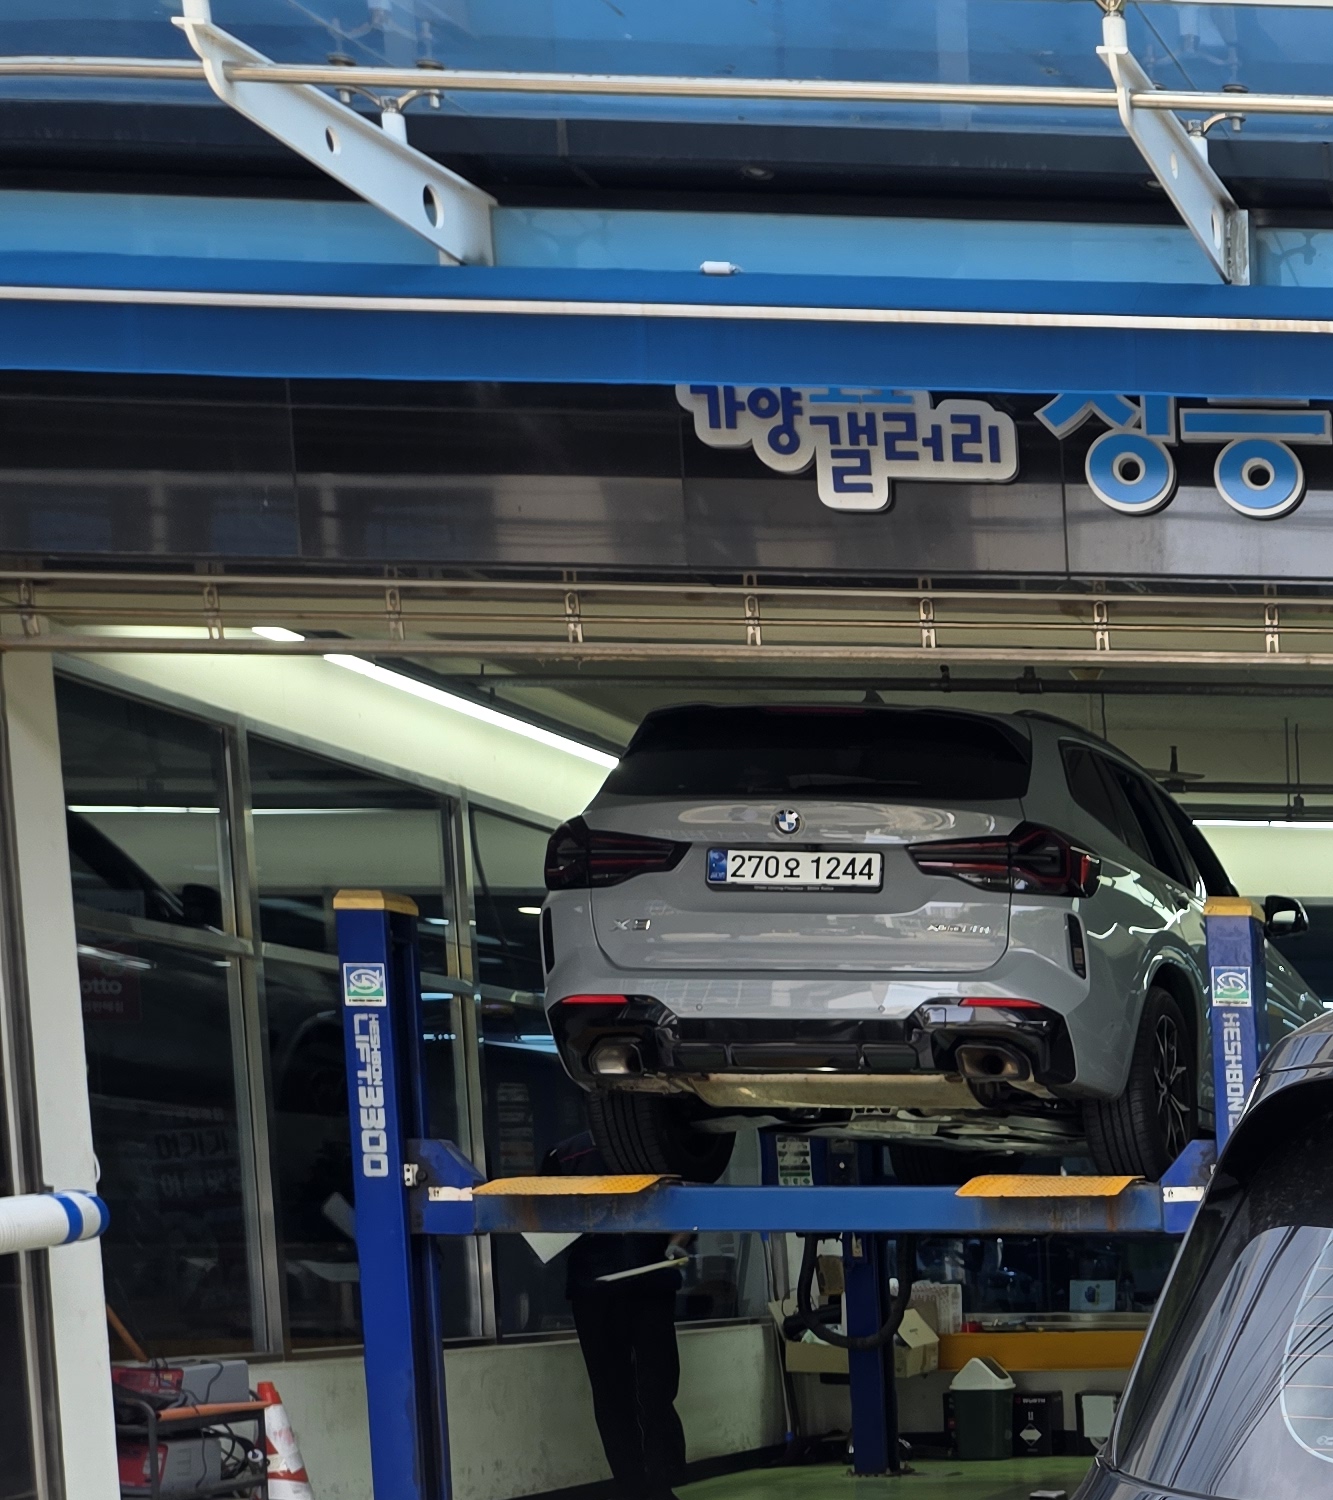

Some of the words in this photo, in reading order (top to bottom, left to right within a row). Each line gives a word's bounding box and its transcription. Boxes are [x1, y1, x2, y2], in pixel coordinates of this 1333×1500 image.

[689, 385, 803, 455] 가양
[809, 412, 1001, 493] 갤러리
[730, 854, 800, 879] 270오
[811, 856, 874, 881] 1244
[367, 1013, 384, 1086] HESHBON
